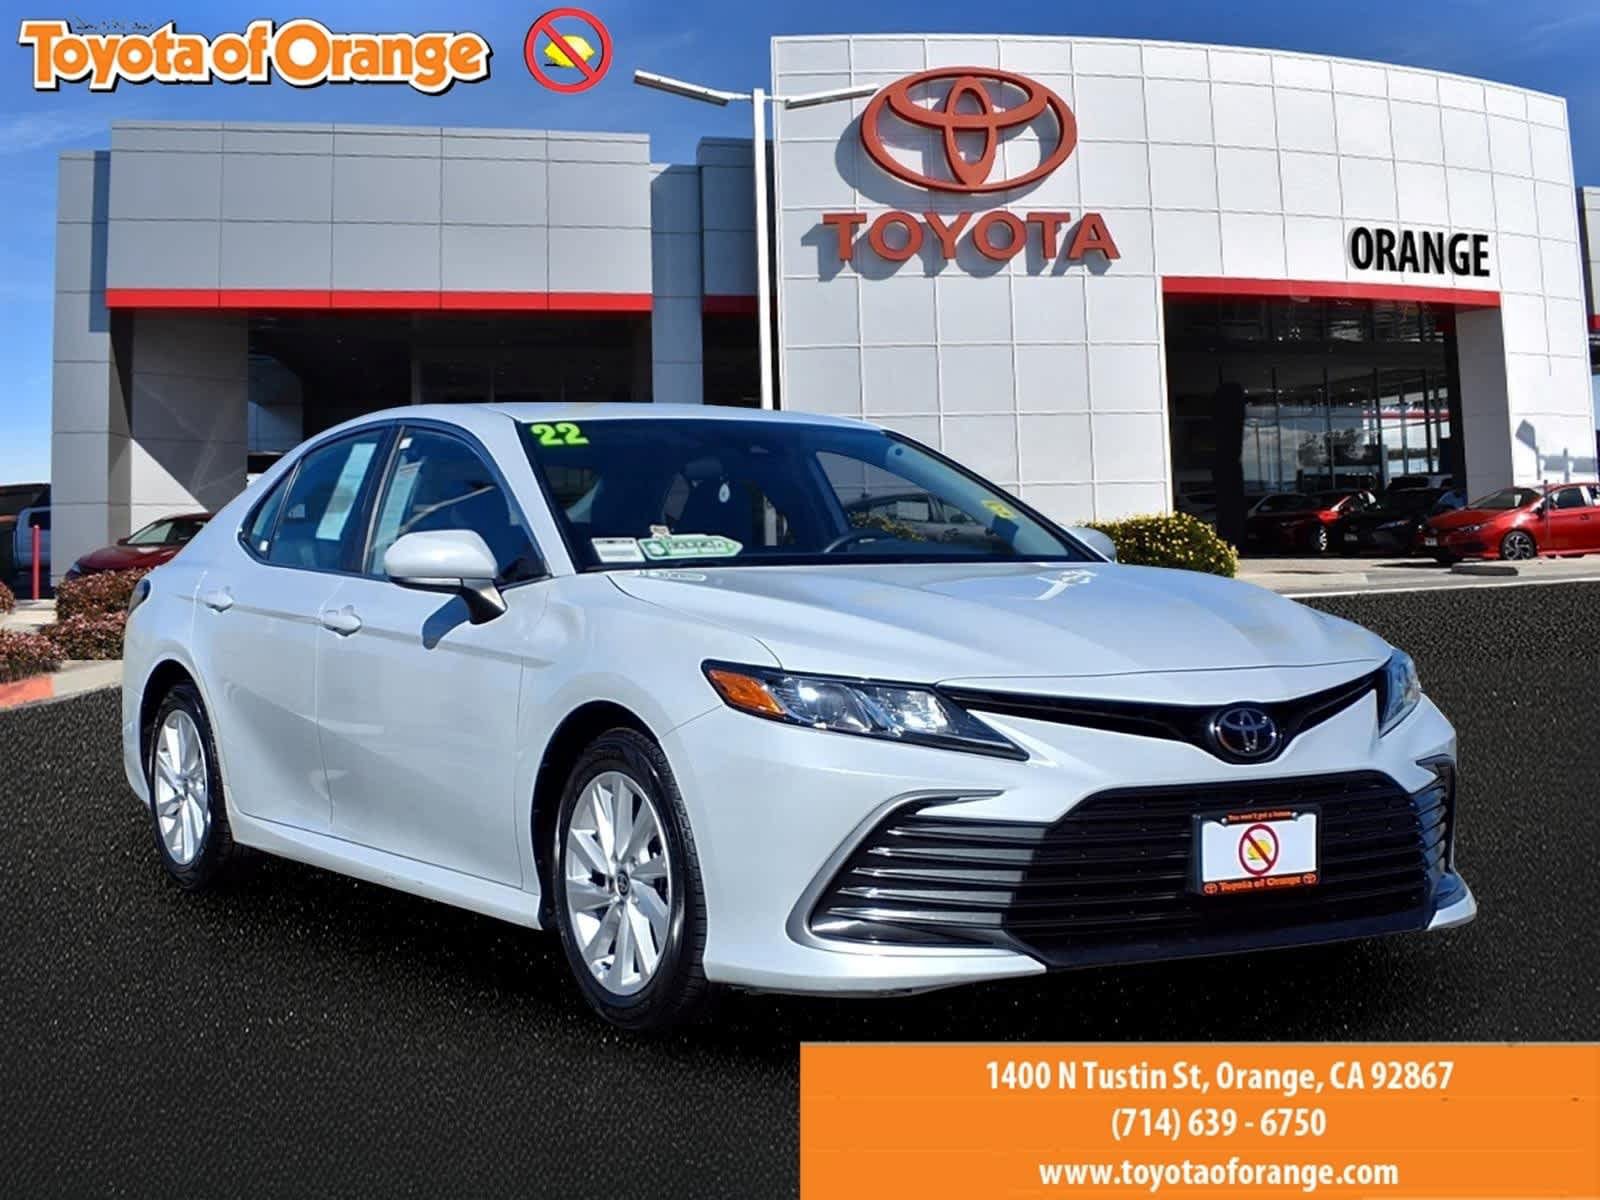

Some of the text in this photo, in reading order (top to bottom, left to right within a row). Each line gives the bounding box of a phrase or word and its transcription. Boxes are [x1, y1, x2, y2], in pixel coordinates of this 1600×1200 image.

[822, 211, 1120, 262] TOYOTA
[1350, 226, 1491, 277] ORANGE
[530, 422, 590, 447] 22
[1219, 875, 1301, 892] Toyota of Orange
